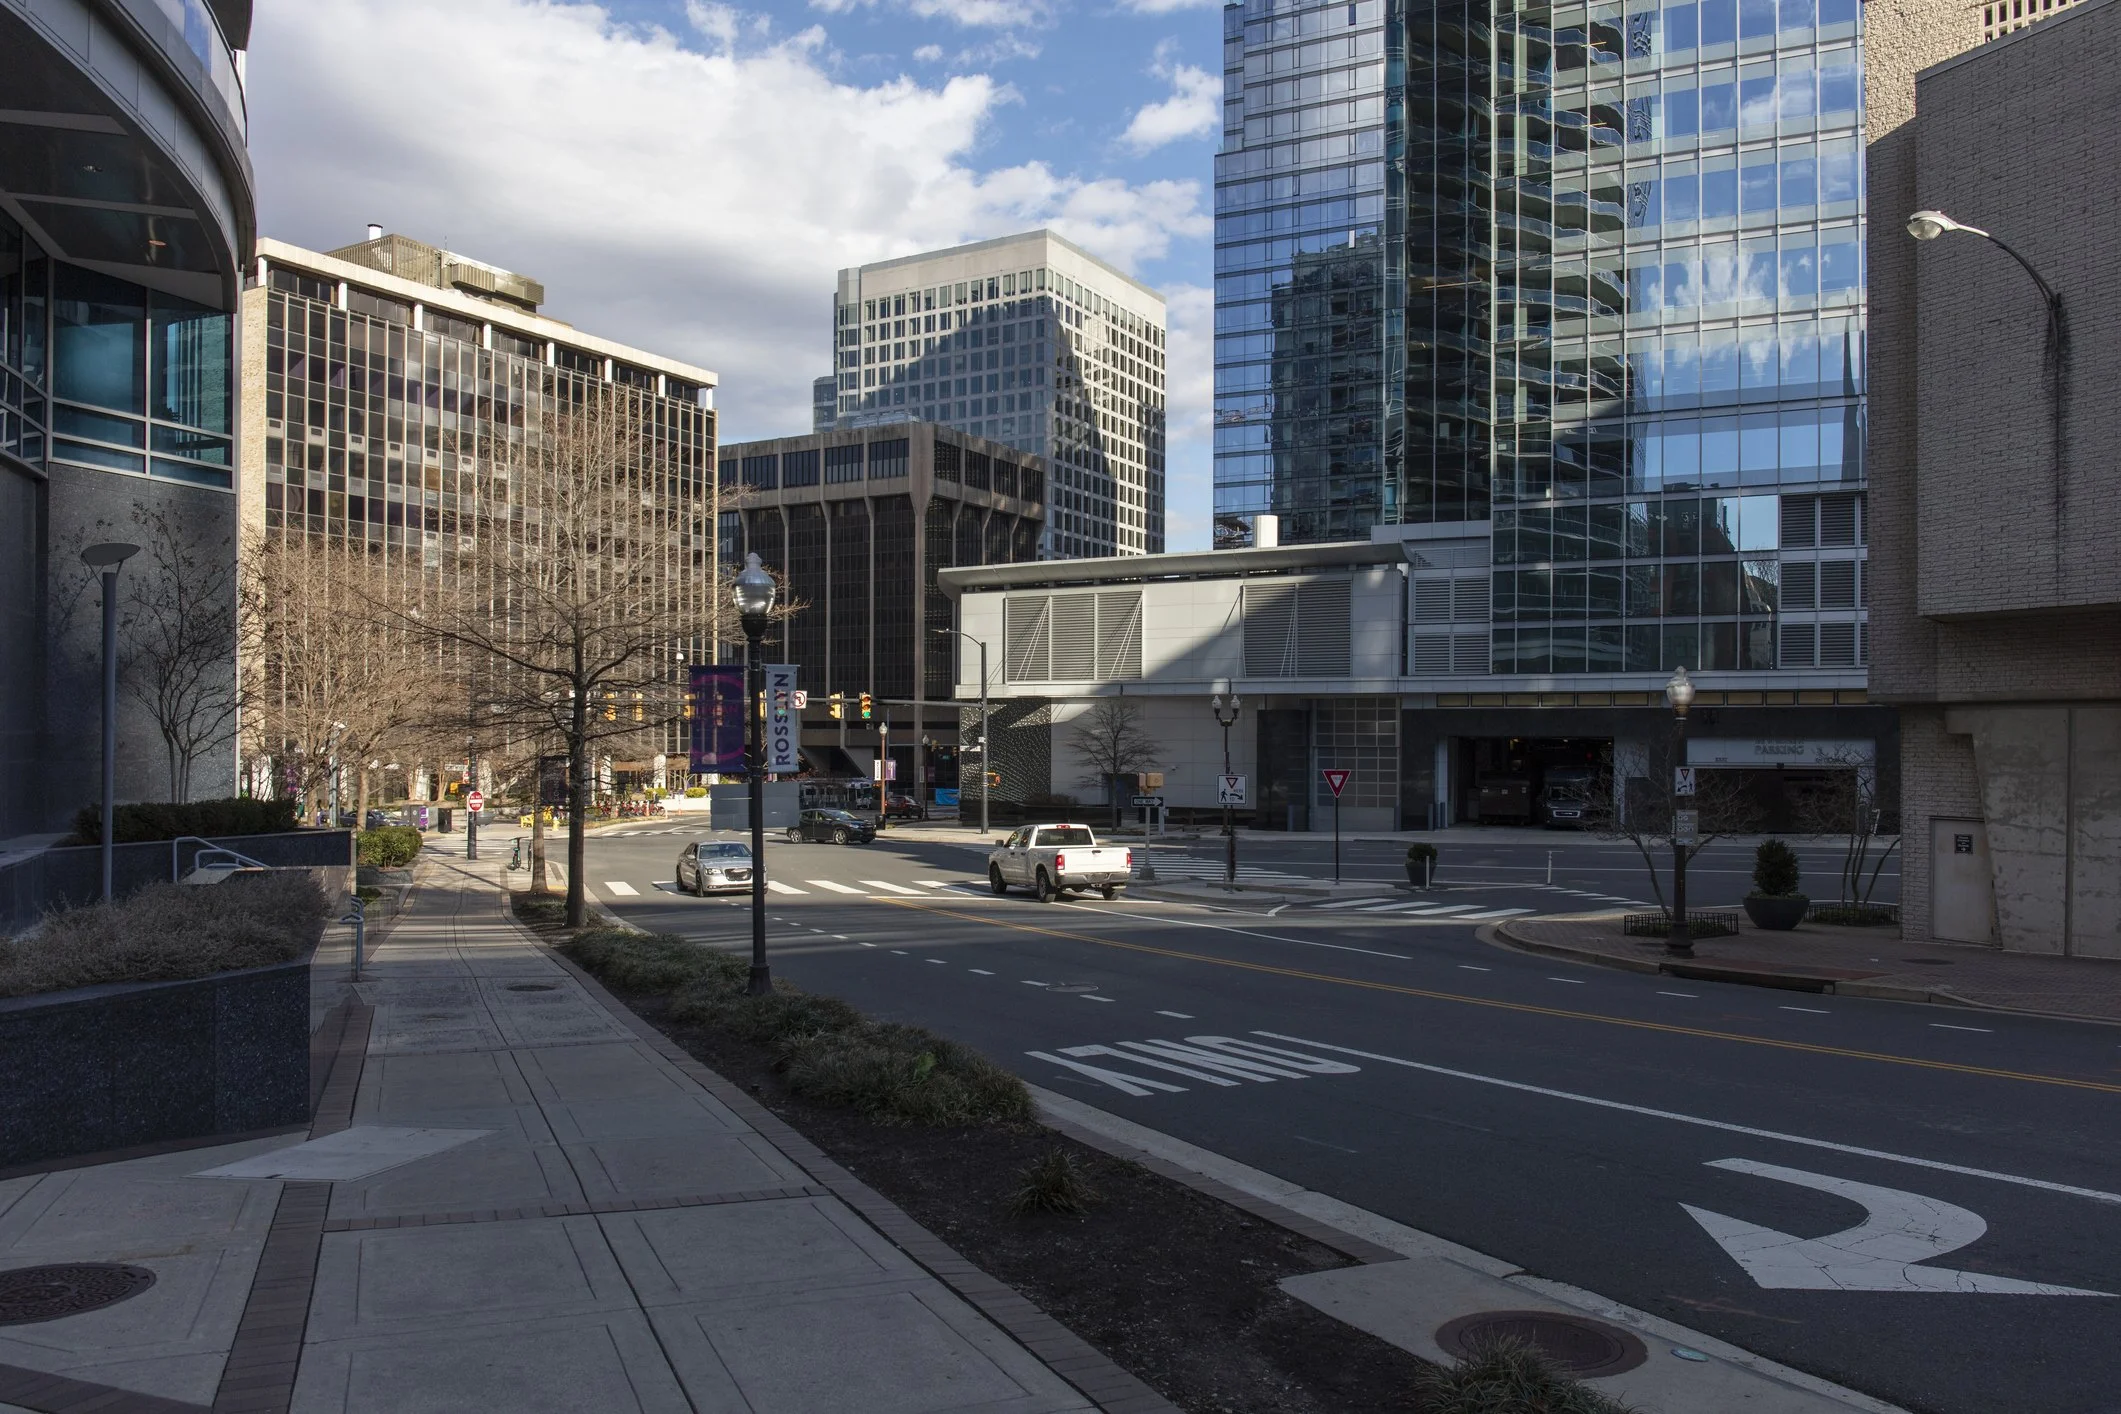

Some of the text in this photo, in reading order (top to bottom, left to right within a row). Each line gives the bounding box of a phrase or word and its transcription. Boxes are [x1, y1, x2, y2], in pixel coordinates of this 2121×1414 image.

[774, 673, 790, 766] ROSSLYN
[1754, 744, 1805, 755] PARKING
[1024, 1036, 1361, 1096] ONLY
